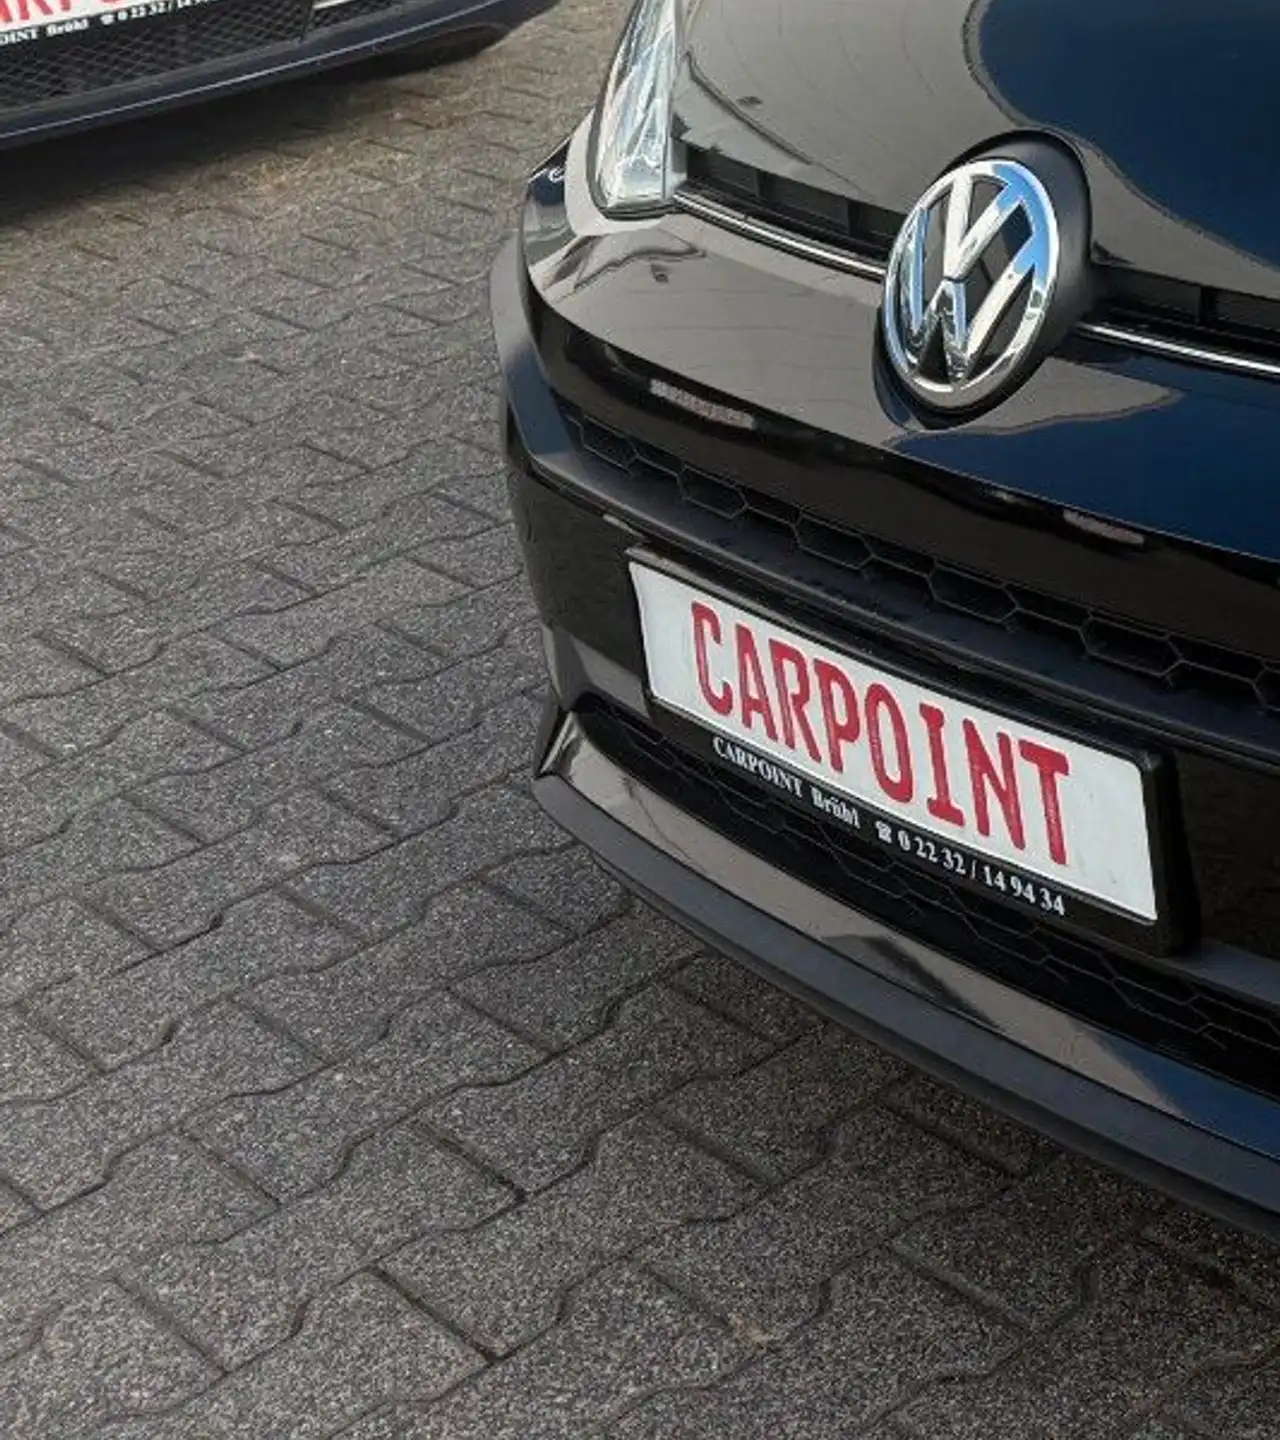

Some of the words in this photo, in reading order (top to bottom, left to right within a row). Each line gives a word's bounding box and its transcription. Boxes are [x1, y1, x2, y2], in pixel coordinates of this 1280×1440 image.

[691, 600, 1070, 865] CARPOINT
[712, 736, 803, 799] CARPOINT
[811, 785, 861, 829] Brühl
[898, 829, 912, 852] 0
[915, 836, 938, 863] 22
[941, 847, 966, 875] 32
[983, 865, 1007, 893] 14
[1010, 875, 1036, 904] 94
[1040, 887, 1065, 916] 34
